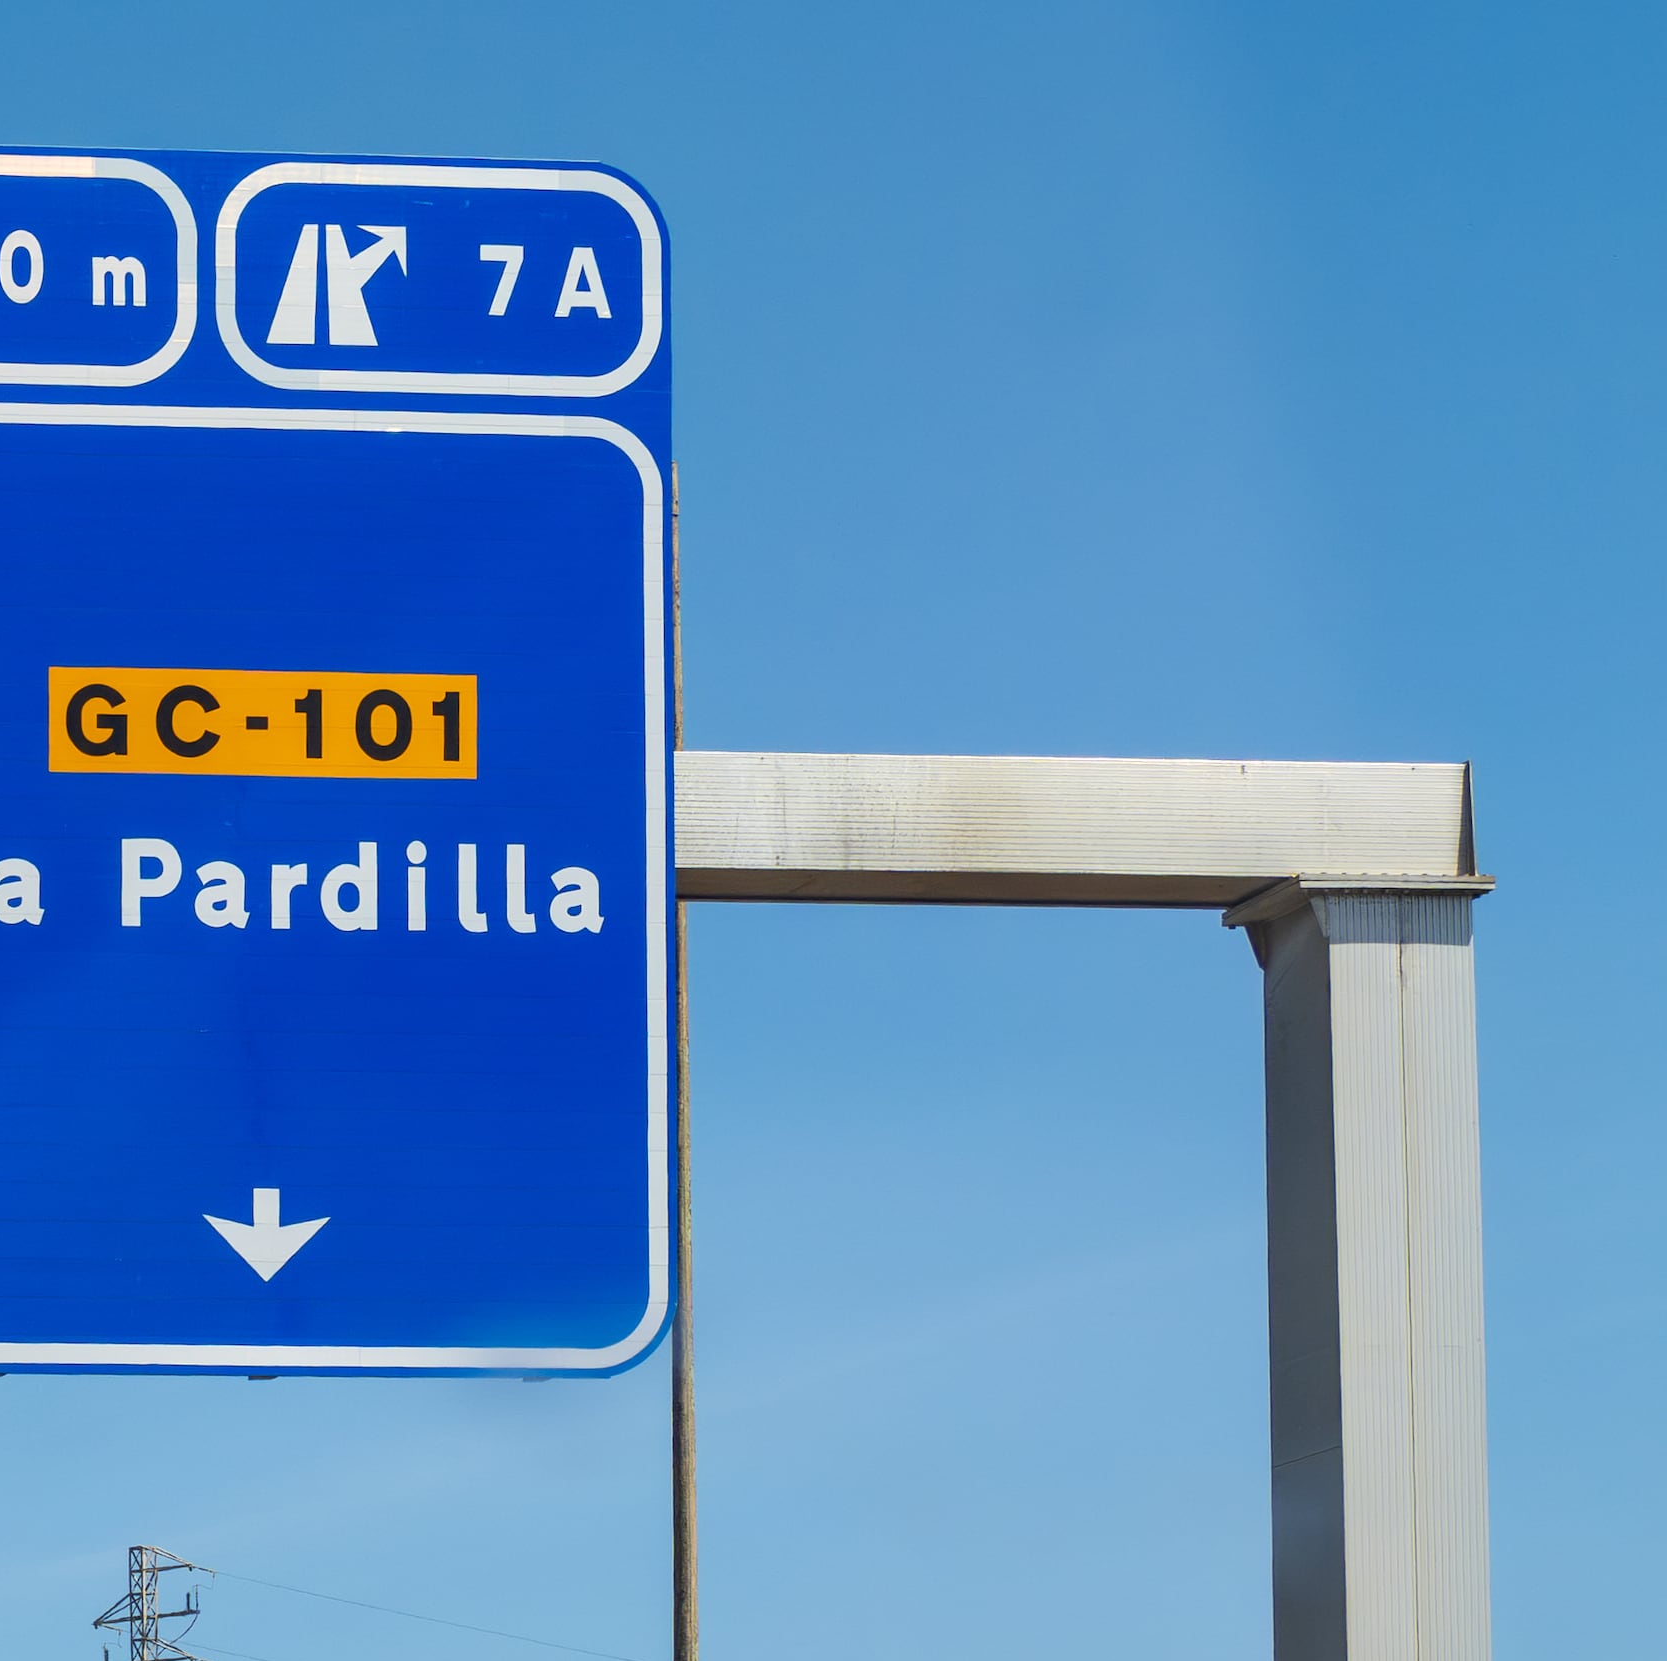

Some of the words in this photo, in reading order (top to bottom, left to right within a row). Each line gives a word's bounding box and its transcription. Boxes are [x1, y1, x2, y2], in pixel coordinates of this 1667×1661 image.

[91, 255, 147, 307] m
[66, 683, 461, 763] GC-101
[121, 838, 605, 934] Pardilla
